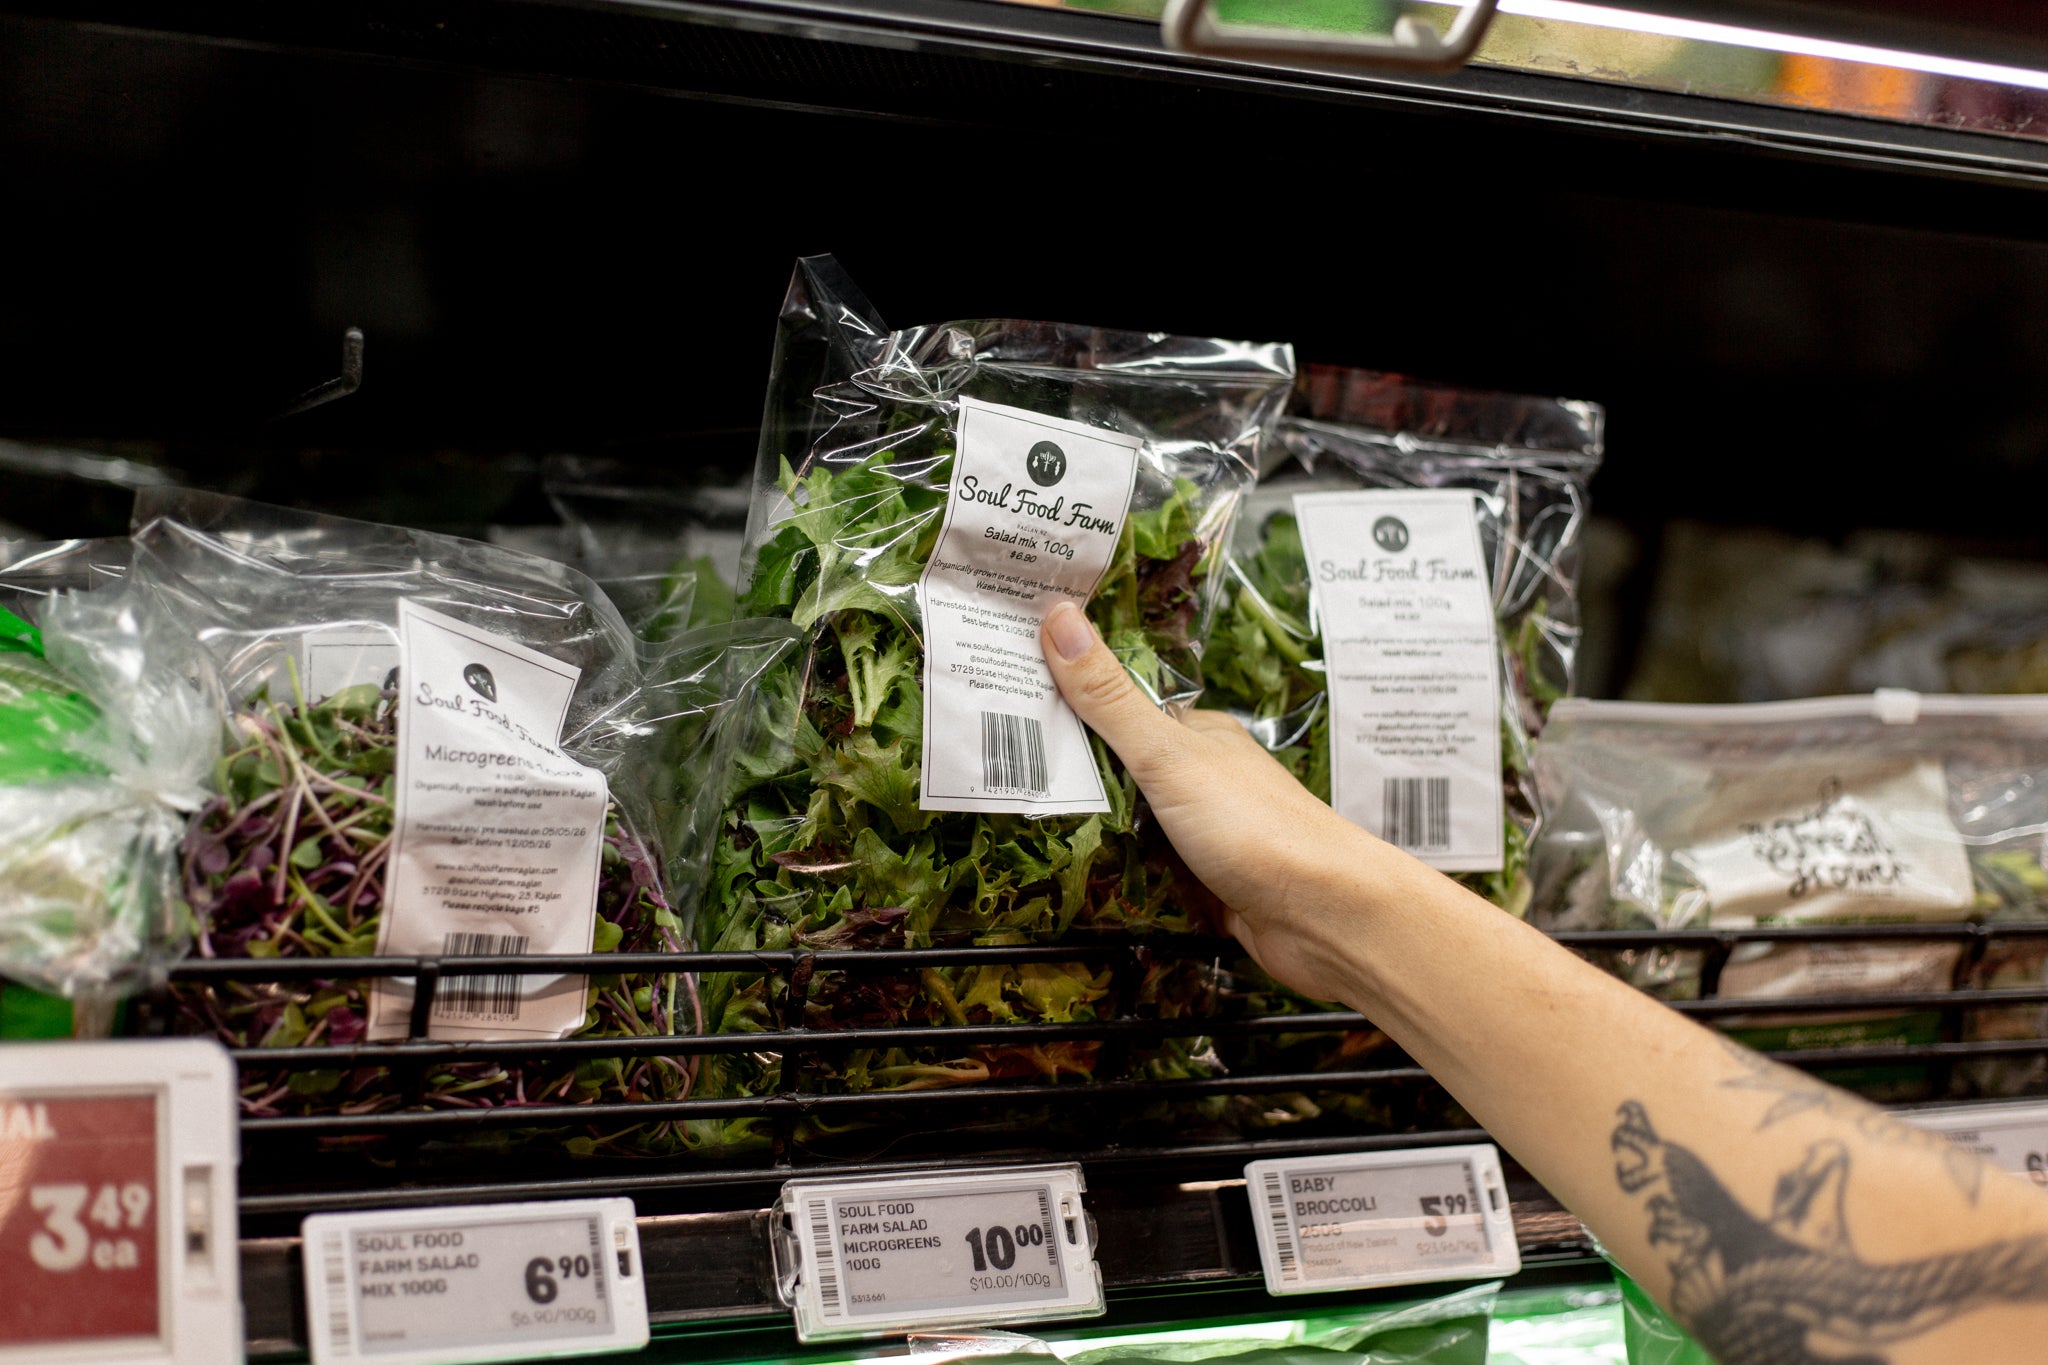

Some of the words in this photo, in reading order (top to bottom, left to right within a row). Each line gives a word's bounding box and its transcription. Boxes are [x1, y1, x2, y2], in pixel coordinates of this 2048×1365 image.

[959, 475, 1011, 508] Soul
[1011, 489, 1064, 522] Food
[1064, 503, 1116, 535] Farm
[984, 526, 1018, 544] Salad
[1018, 537, 1038, 549] mix
[1044, 540, 1074, 560] 100g
[1010, 550, 1037, 563] $6.90
[934, 559, 973, 574] Organically
[973, 569, 997, 580] grown
[998, 572, 1004, 580] in
[1005, 574, 1019, 584] soil
[1019, 577, 1038, 589] right
[1039, 580, 1055, 592] here
[1055, 584, 1062, 592] in
[1063, 586, 1088, 598] Raglan
[1320, 558, 1367, 582] Soul
[1373, 558, 1420, 582] Food
[1426, 558, 1477, 582] Farm
[976, 580, 996, 592] Wash
[996, 585, 1020, 597] before
[1021, 592, 1034, 600] use
[930, 597, 967, 611] Harvested
[967, 602, 979, 613] and
[980, 608, 992, 617] pre
[992, 609, 1017, 622] washed
[1017, 615, 1027, 623] on
[962, 614, 978, 626] Best
[979, 619, 1000, 631] before
[950, 664, 974, 674] 3729
[975, 667, 997, 678] State
[997, 672, 1024, 684] Highway
[969, 680, 994, 690] Please
[994, 683, 1019, 694] recycle
[1019, 688, 1034, 699] bags
[1035, 691, 1044, 700] #5
[417, 682, 466, 712] Soul
[470, 700, 514, 732] Food
[425, 745, 534, 769] Microgreens
[534, 891, 562, 903] Raglan
[1291, 1176, 1335, 1194] BABY
[839, 1205, 876, 1219] SOUL
[878, 1202, 914, 1216] FOOD
[1296, 1196, 1377, 1217] BROCCOLI
[841, 1222, 879, 1236] FARM
[882, 1219, 928, 1234] SALAD
[357, 1236, 406, 1252] SOUL
[413, 1232, 464, 1249] FOOD
[844, 1236, 941, 1254] MICROGREENS
[93, 1238, 139, 1271] ea
[359, 1259, 411, 1276] FARM
[417, 1253, 479, 1271] SALAD
[846, 1257, 881, 1271] 100G
[361, 1282, 394, 1298] MIX
[400, 1279, 447, 1295] 100G
[970, 1272, 1050, 1291] $10.00/100g
